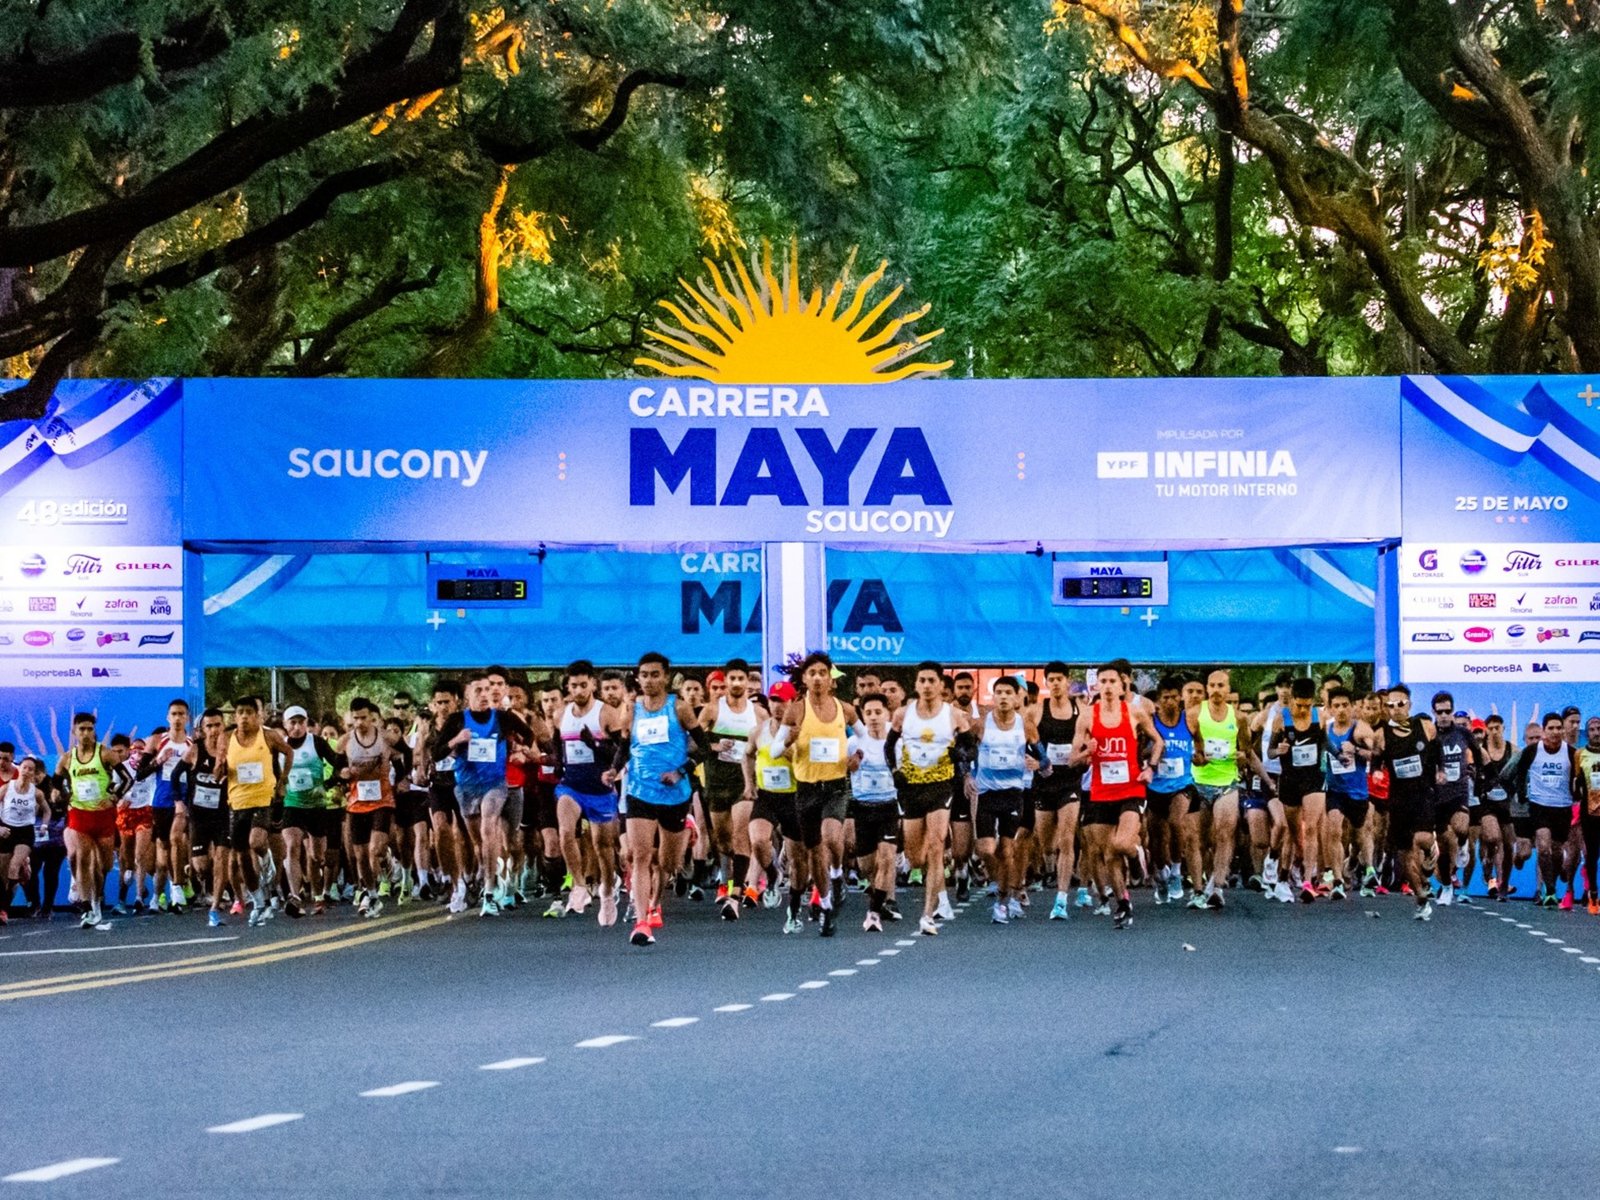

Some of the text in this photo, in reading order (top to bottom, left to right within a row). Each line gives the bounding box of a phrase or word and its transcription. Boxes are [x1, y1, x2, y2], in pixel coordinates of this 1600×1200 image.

[628, 387, 830, 418] CARRERA
[1156, 428, 1245, 441] IMPULSADA POR
[287, 446, 489, 488] saucony
[629, 427, 953, 507] MAYA
[1106, 450, 1298, 478] YPF INFINIA
[1155, 483, 1298, 497] TU MOTOR INTERNO
[1454, 496, 1569, 512] 25 DE MAYO
[16, 499, 129, 527] 48 edición
[805, 508, 956, 539] saucony
[115, 562, 173, 571] GILERA
[680, 551, 762, 575] CARR
[1554, 558, 1600, 567] GILER
[466, 568, 500, 578] MAYA
[1090, 566, 1124, 576] MAYA
[1469, 593, 1497, 601] ULTRA
[827, 635, 905, 656] ucony
[91, 667, 110, 678] BA
[1463, 663, 1523, 674] DeportesBA
[1532, 662, 1550, 673] BA
[22, 668, 83, 680] DeportesBA
[477, 746, 487, 754] 72
[1541, 761, 1563, 771] ARG
[10, 797, 30, 807] ARG
